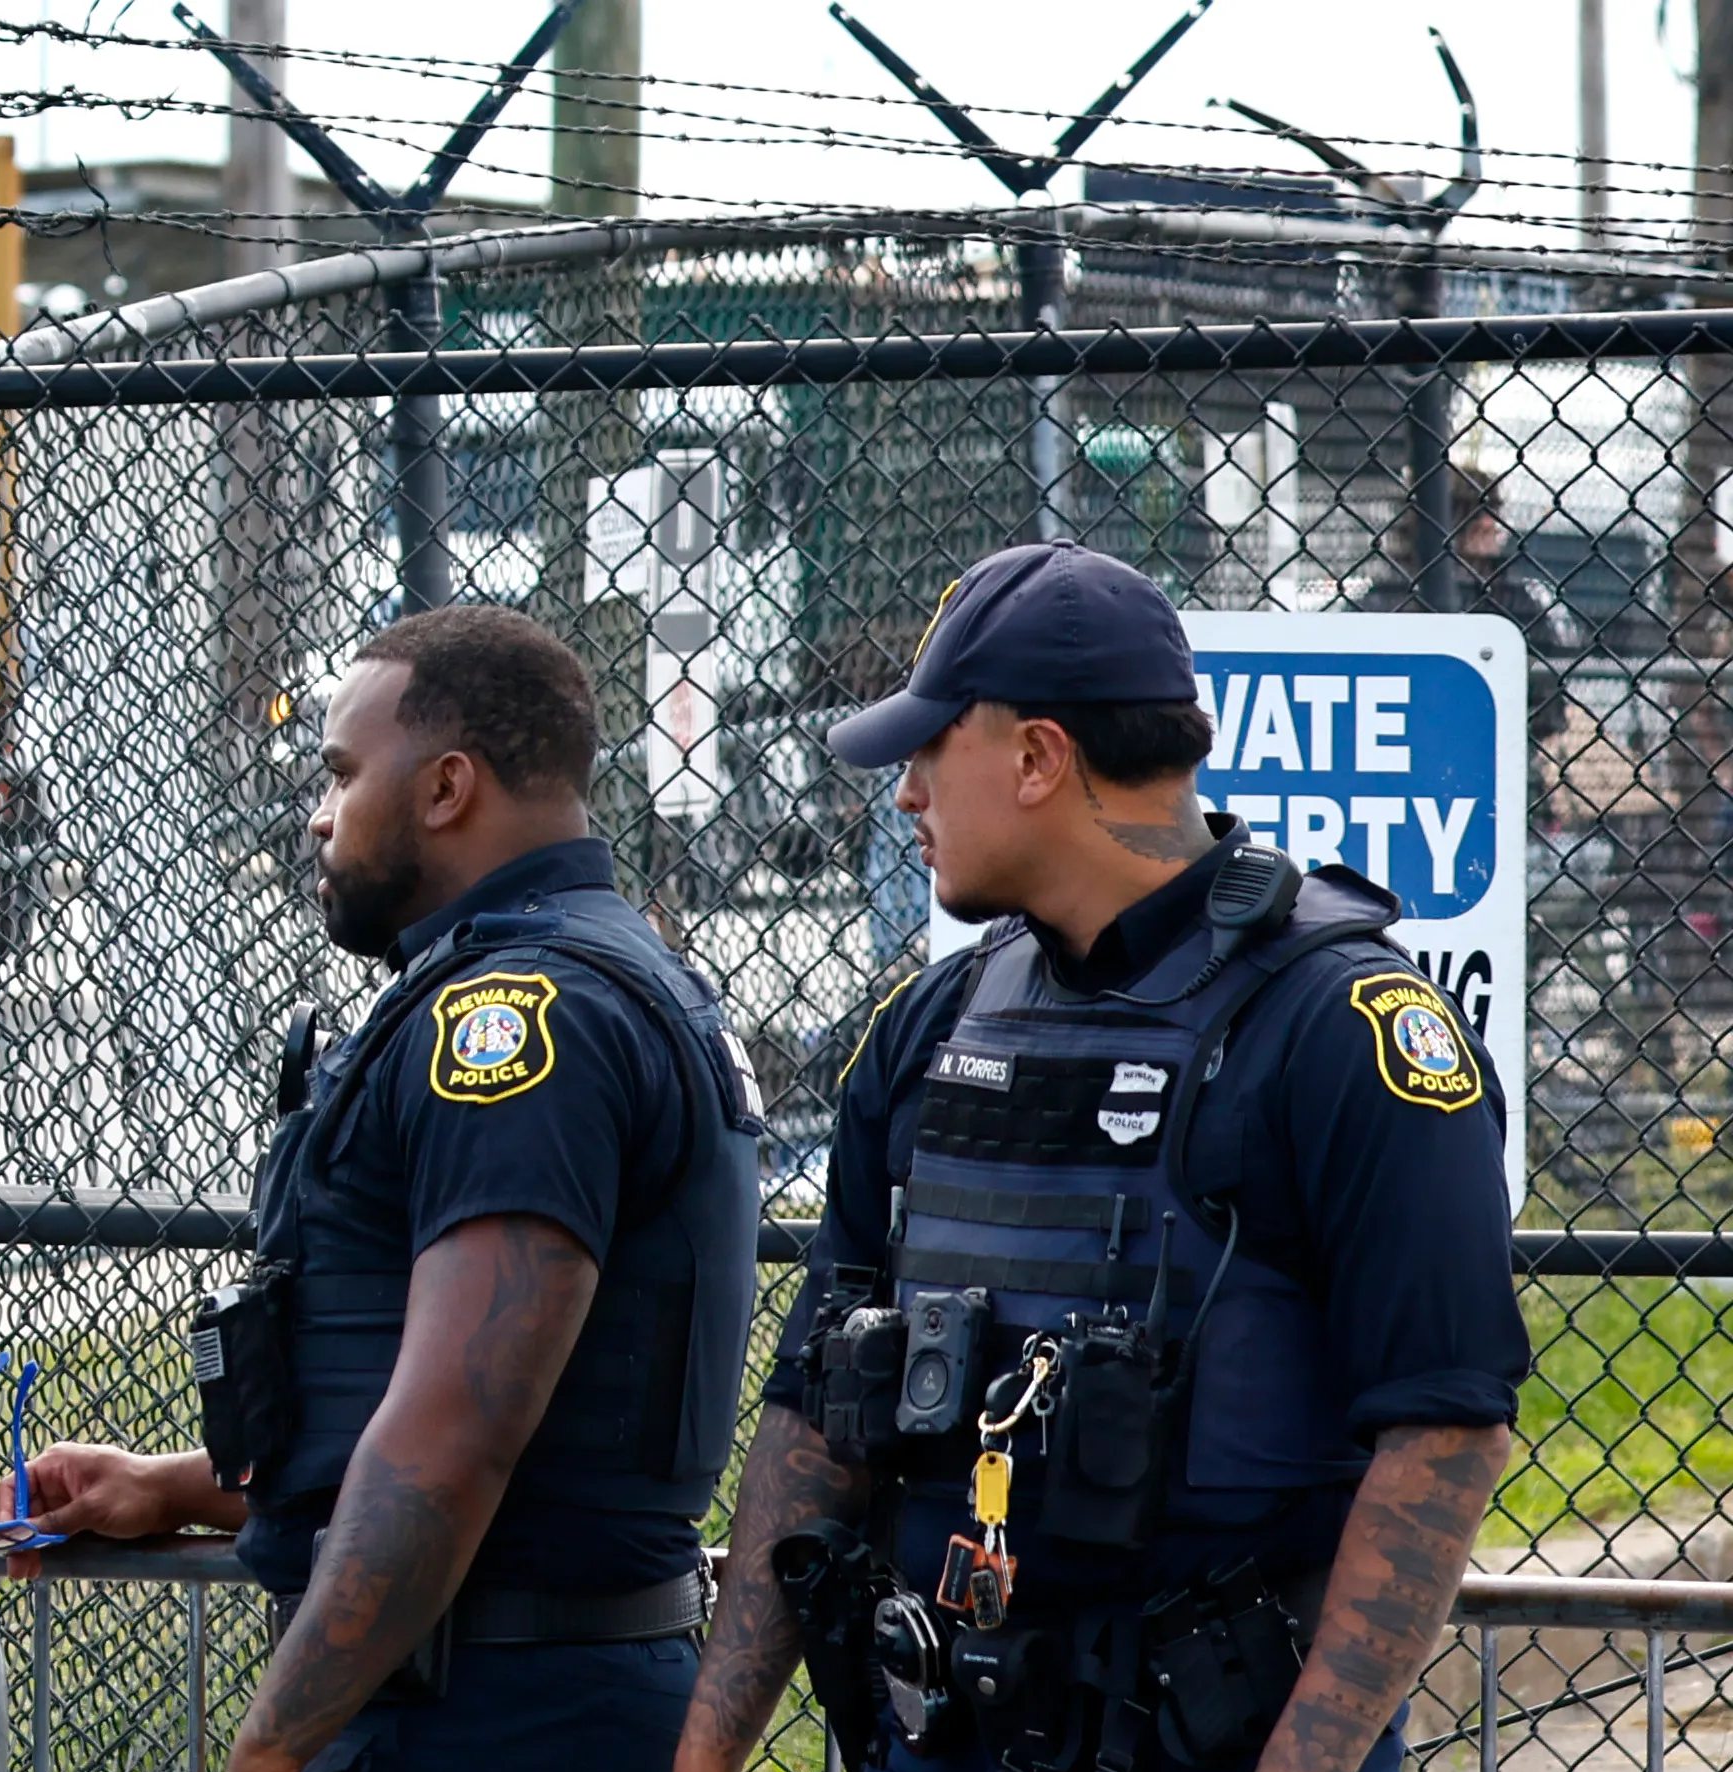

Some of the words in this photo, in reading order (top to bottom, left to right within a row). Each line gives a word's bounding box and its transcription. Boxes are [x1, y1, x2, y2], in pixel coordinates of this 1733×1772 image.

[1197, 794, 1480, 895] ERTY
[447, 988, 540, 1019] NEWARK
[1370, 987, 1445, 1016] NEWARK
[449, 1061, 529, 1086] POLICE
[956, 1055, 1008, 1083] TORRES
[1124, 1070, 1157, 1085] NEWARK
[1408, 1071, 1472, 1092] POLICE
[1107, 1115, 1145, 1131] POLICE
